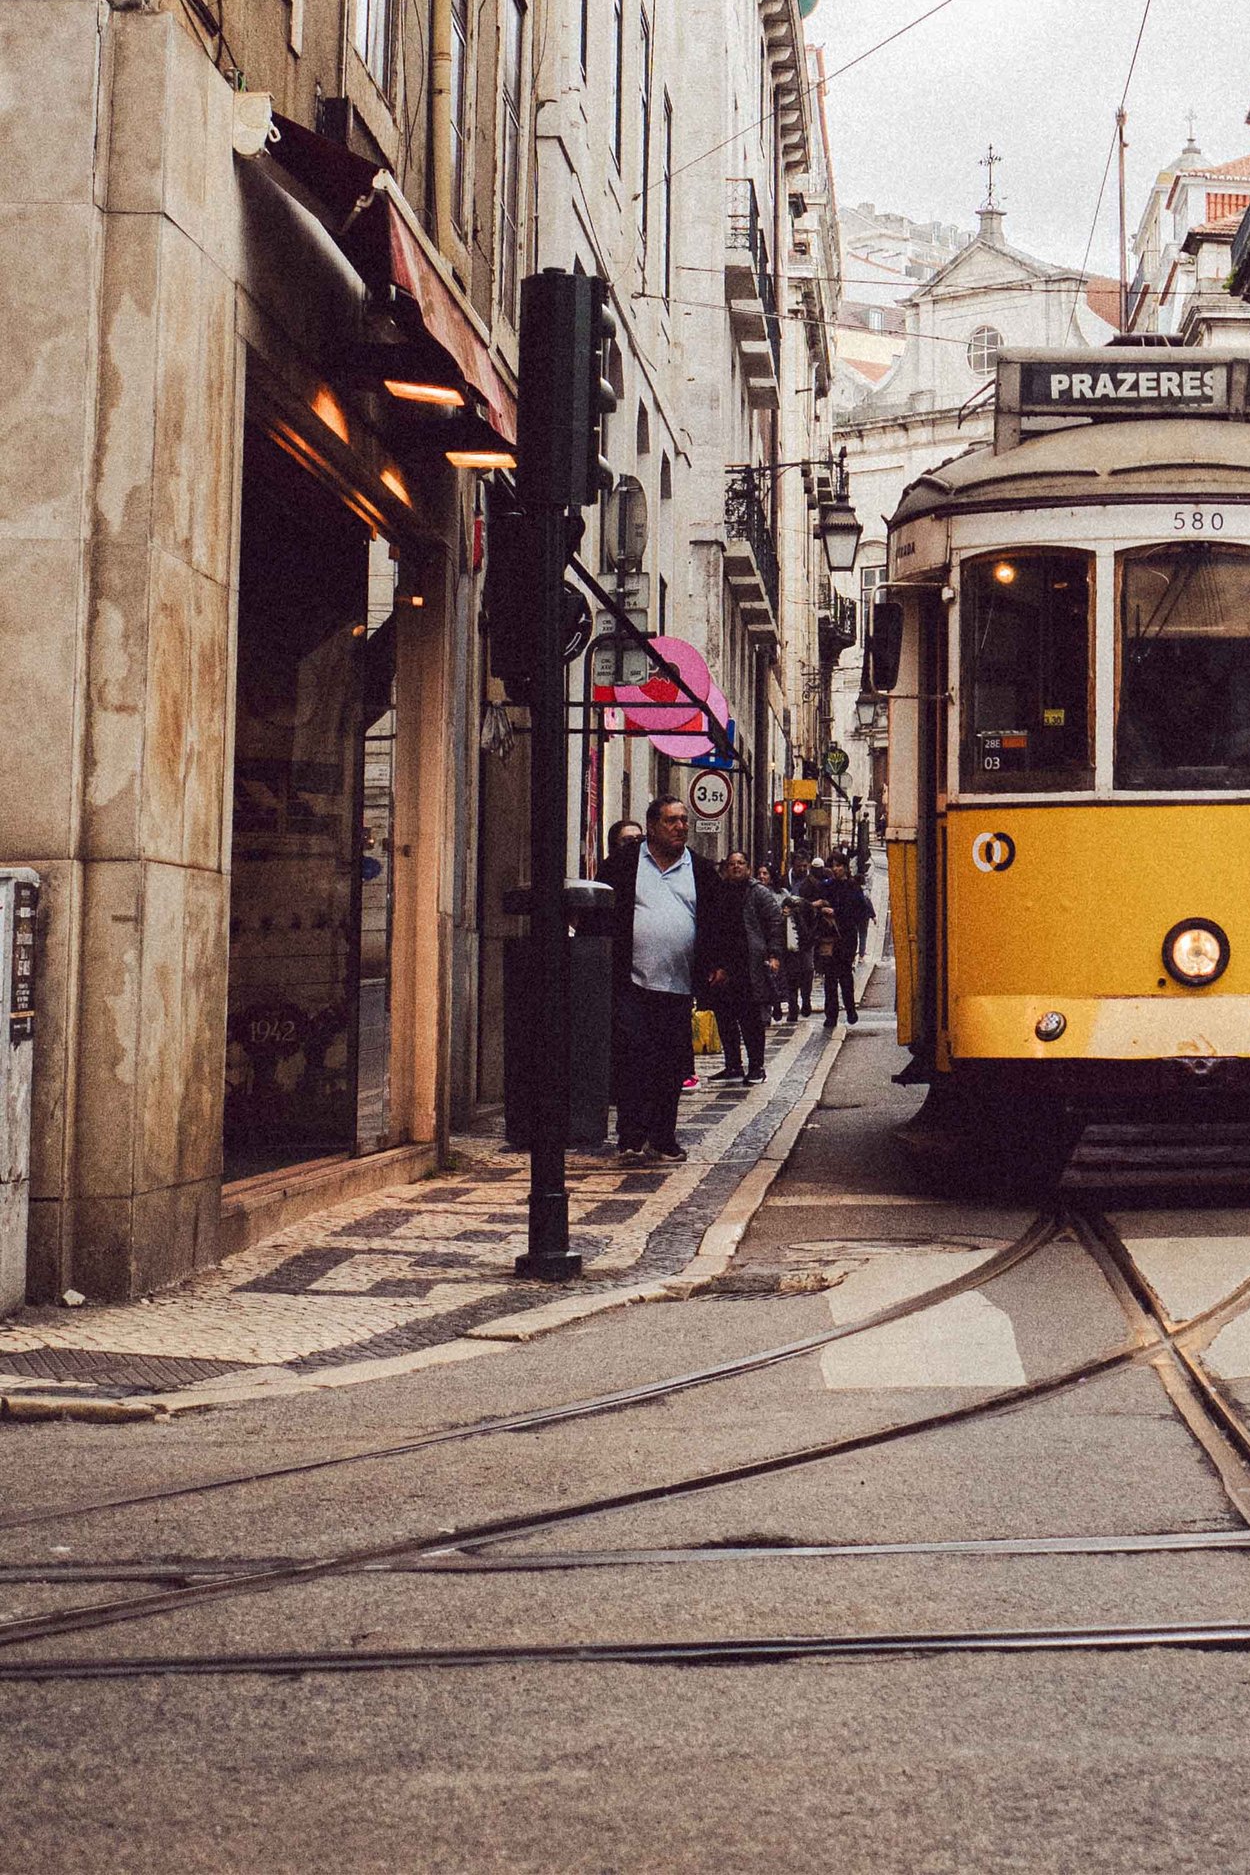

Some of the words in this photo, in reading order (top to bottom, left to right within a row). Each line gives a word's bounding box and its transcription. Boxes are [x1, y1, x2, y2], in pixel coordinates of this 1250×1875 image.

[1173, 511, 1224, 531] 580
[985, 740, 1000, 748] 28E
[985, 757, 1000, 770] 03
[251, 1020, 295, 1042] 1942
